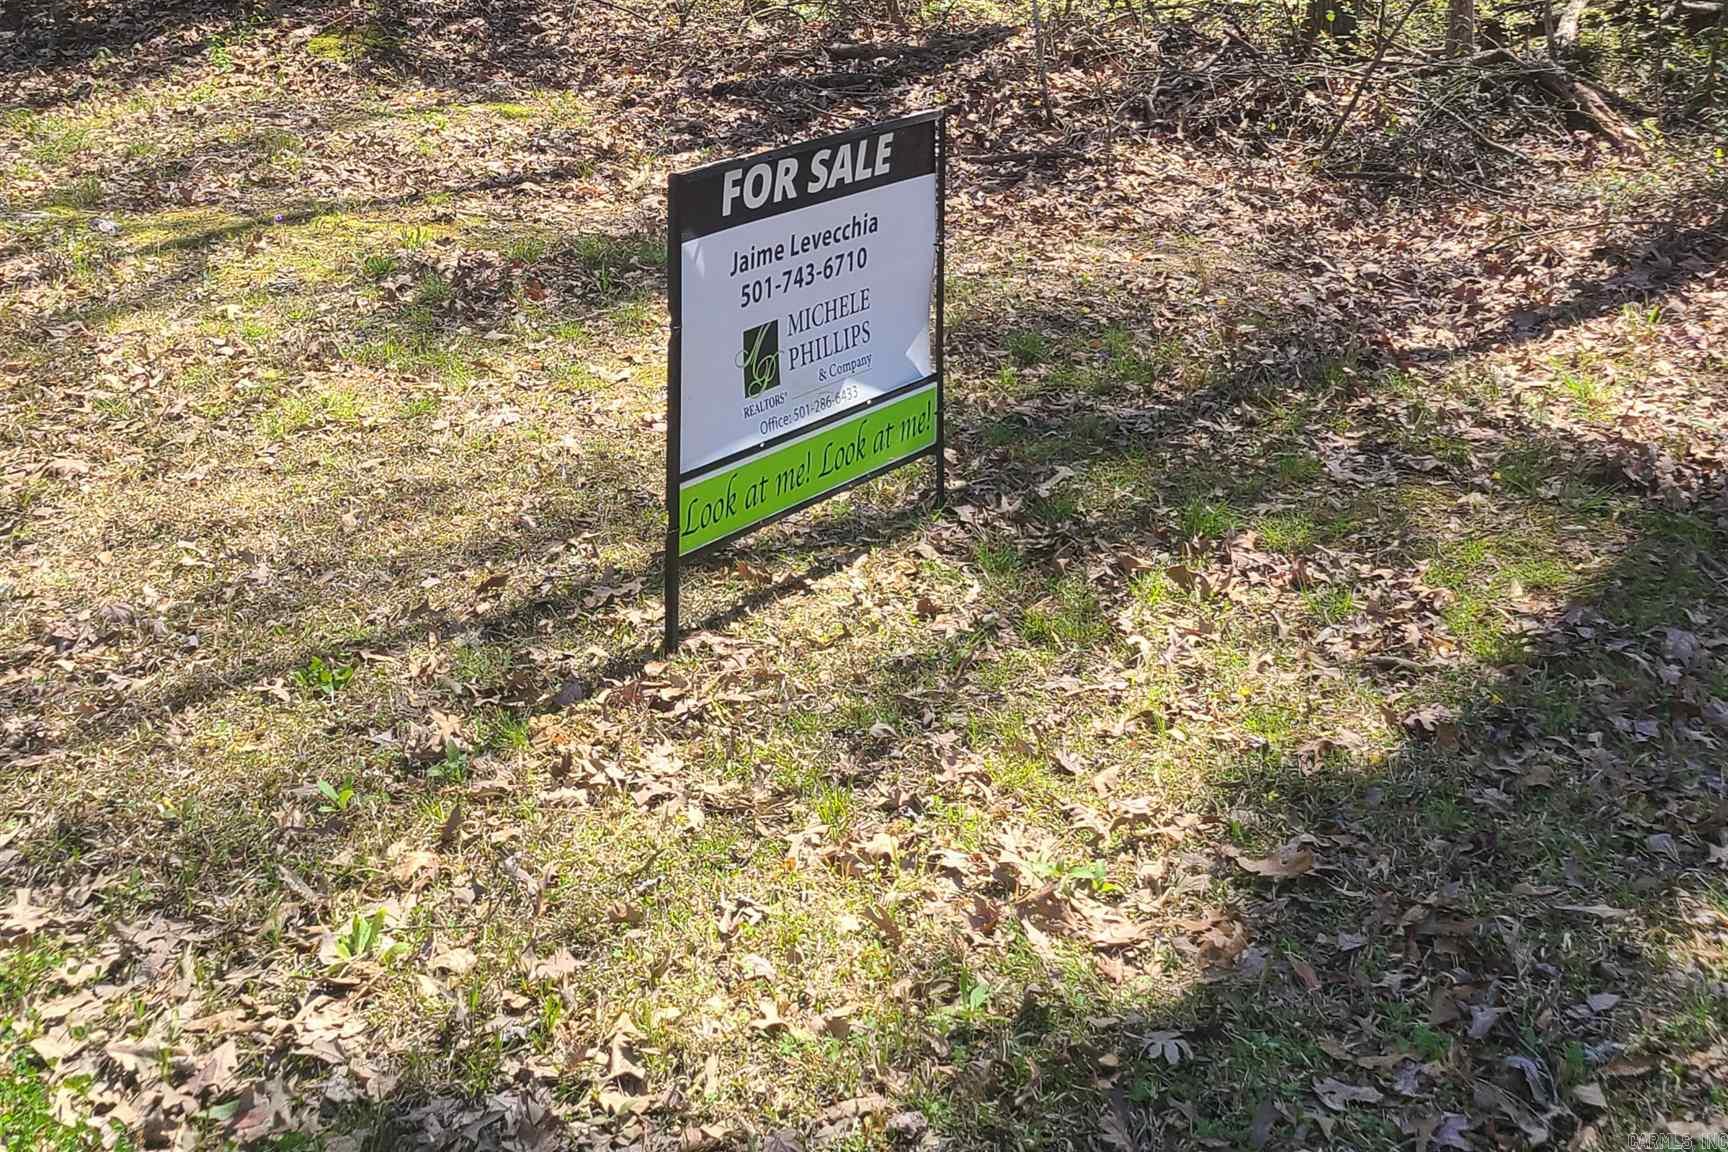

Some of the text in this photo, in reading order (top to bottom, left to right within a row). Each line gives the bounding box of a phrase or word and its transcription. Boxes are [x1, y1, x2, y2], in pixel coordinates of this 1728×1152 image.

[722, 132, 894, 217] FOR SALE
[730, 213, 878, 277] Jaime Levecchia
[740, 247, 867, 308] 501-743-6710
[787, 288, 870, 336] MICHELE
[788, 320, 871, 371] PHILLIPS
[818, 354, 872, 382] & Company
[760, 413, 793, 435] Office:
[682, 399, 932, 537] Look at me! Look at me!
